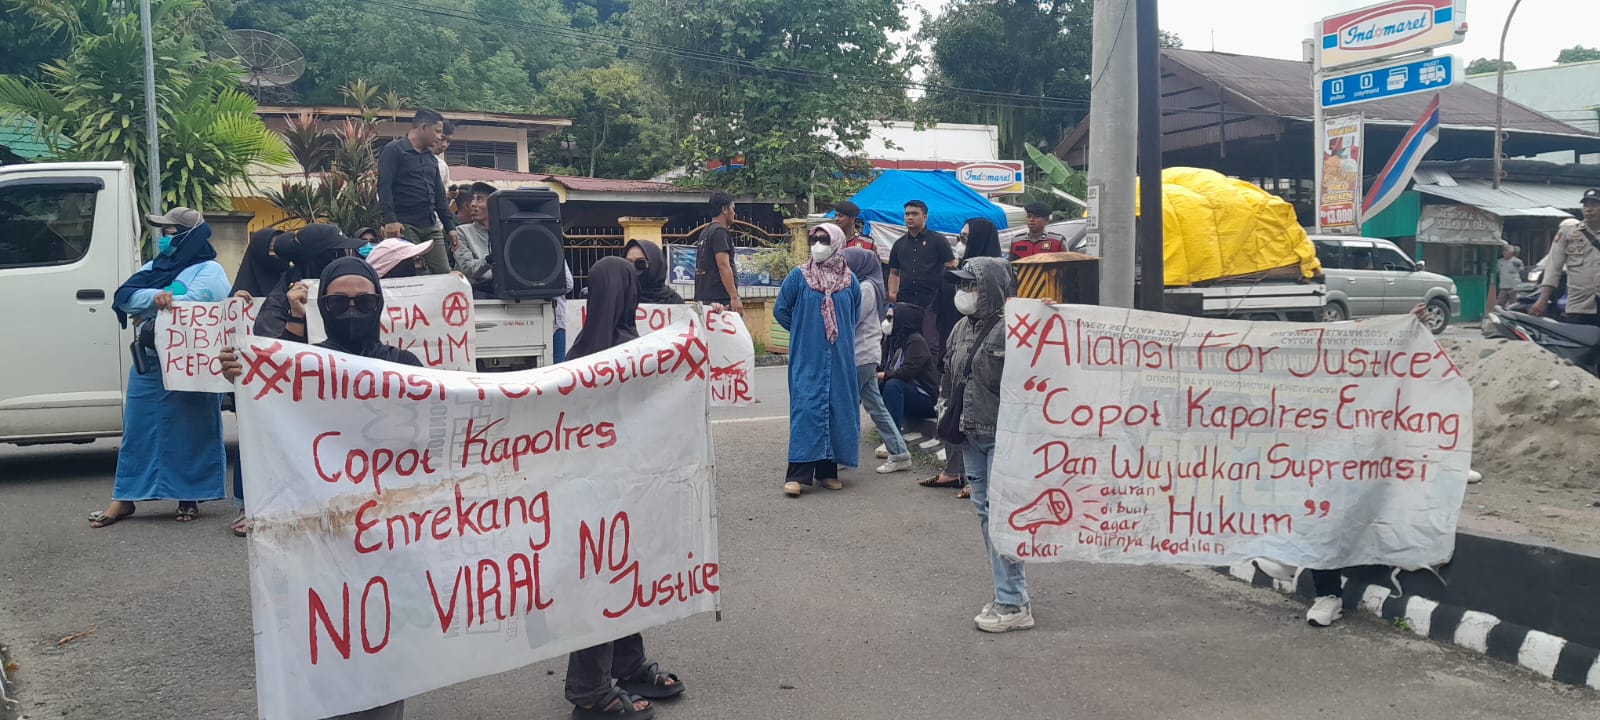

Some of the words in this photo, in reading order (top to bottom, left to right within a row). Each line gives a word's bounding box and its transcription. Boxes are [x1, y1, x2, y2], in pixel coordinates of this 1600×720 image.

[1345, 12, 1427, 45] Indomaret
[964, 169, 1012, 182] Indomaret
[1198, 331, 1279, 373] For
[1187, 387, 1328, 440] Kapolres
[1336, 384, 1460, 449] Enrekang
[312, 430, 436, 496] Copot
[462, 412, 618, 472] Kapolres
[1033, 441, 1097, 480] Dan
[1110, 446, 1262, 492] Wujudkan
[1268, 443, 1428, 487] Supremasi
[1100, 484, 1156, 498] aturan
[1100, 503, 1112, 515] di
[1117, 501, 1148, 515] buat
[354, 484, 552, 554] Enrekang
[1100, 518, 1142, 534] agar
[579, 510, 631, 579] NO
[1016, 540, 1065, 558] akar
[1151, 536, 1226, 556] keadilan
[603, 551, 720, 620] Justice
[309, 575, 391, 665] NO
[426, 552, 554, 634] VIRAL
